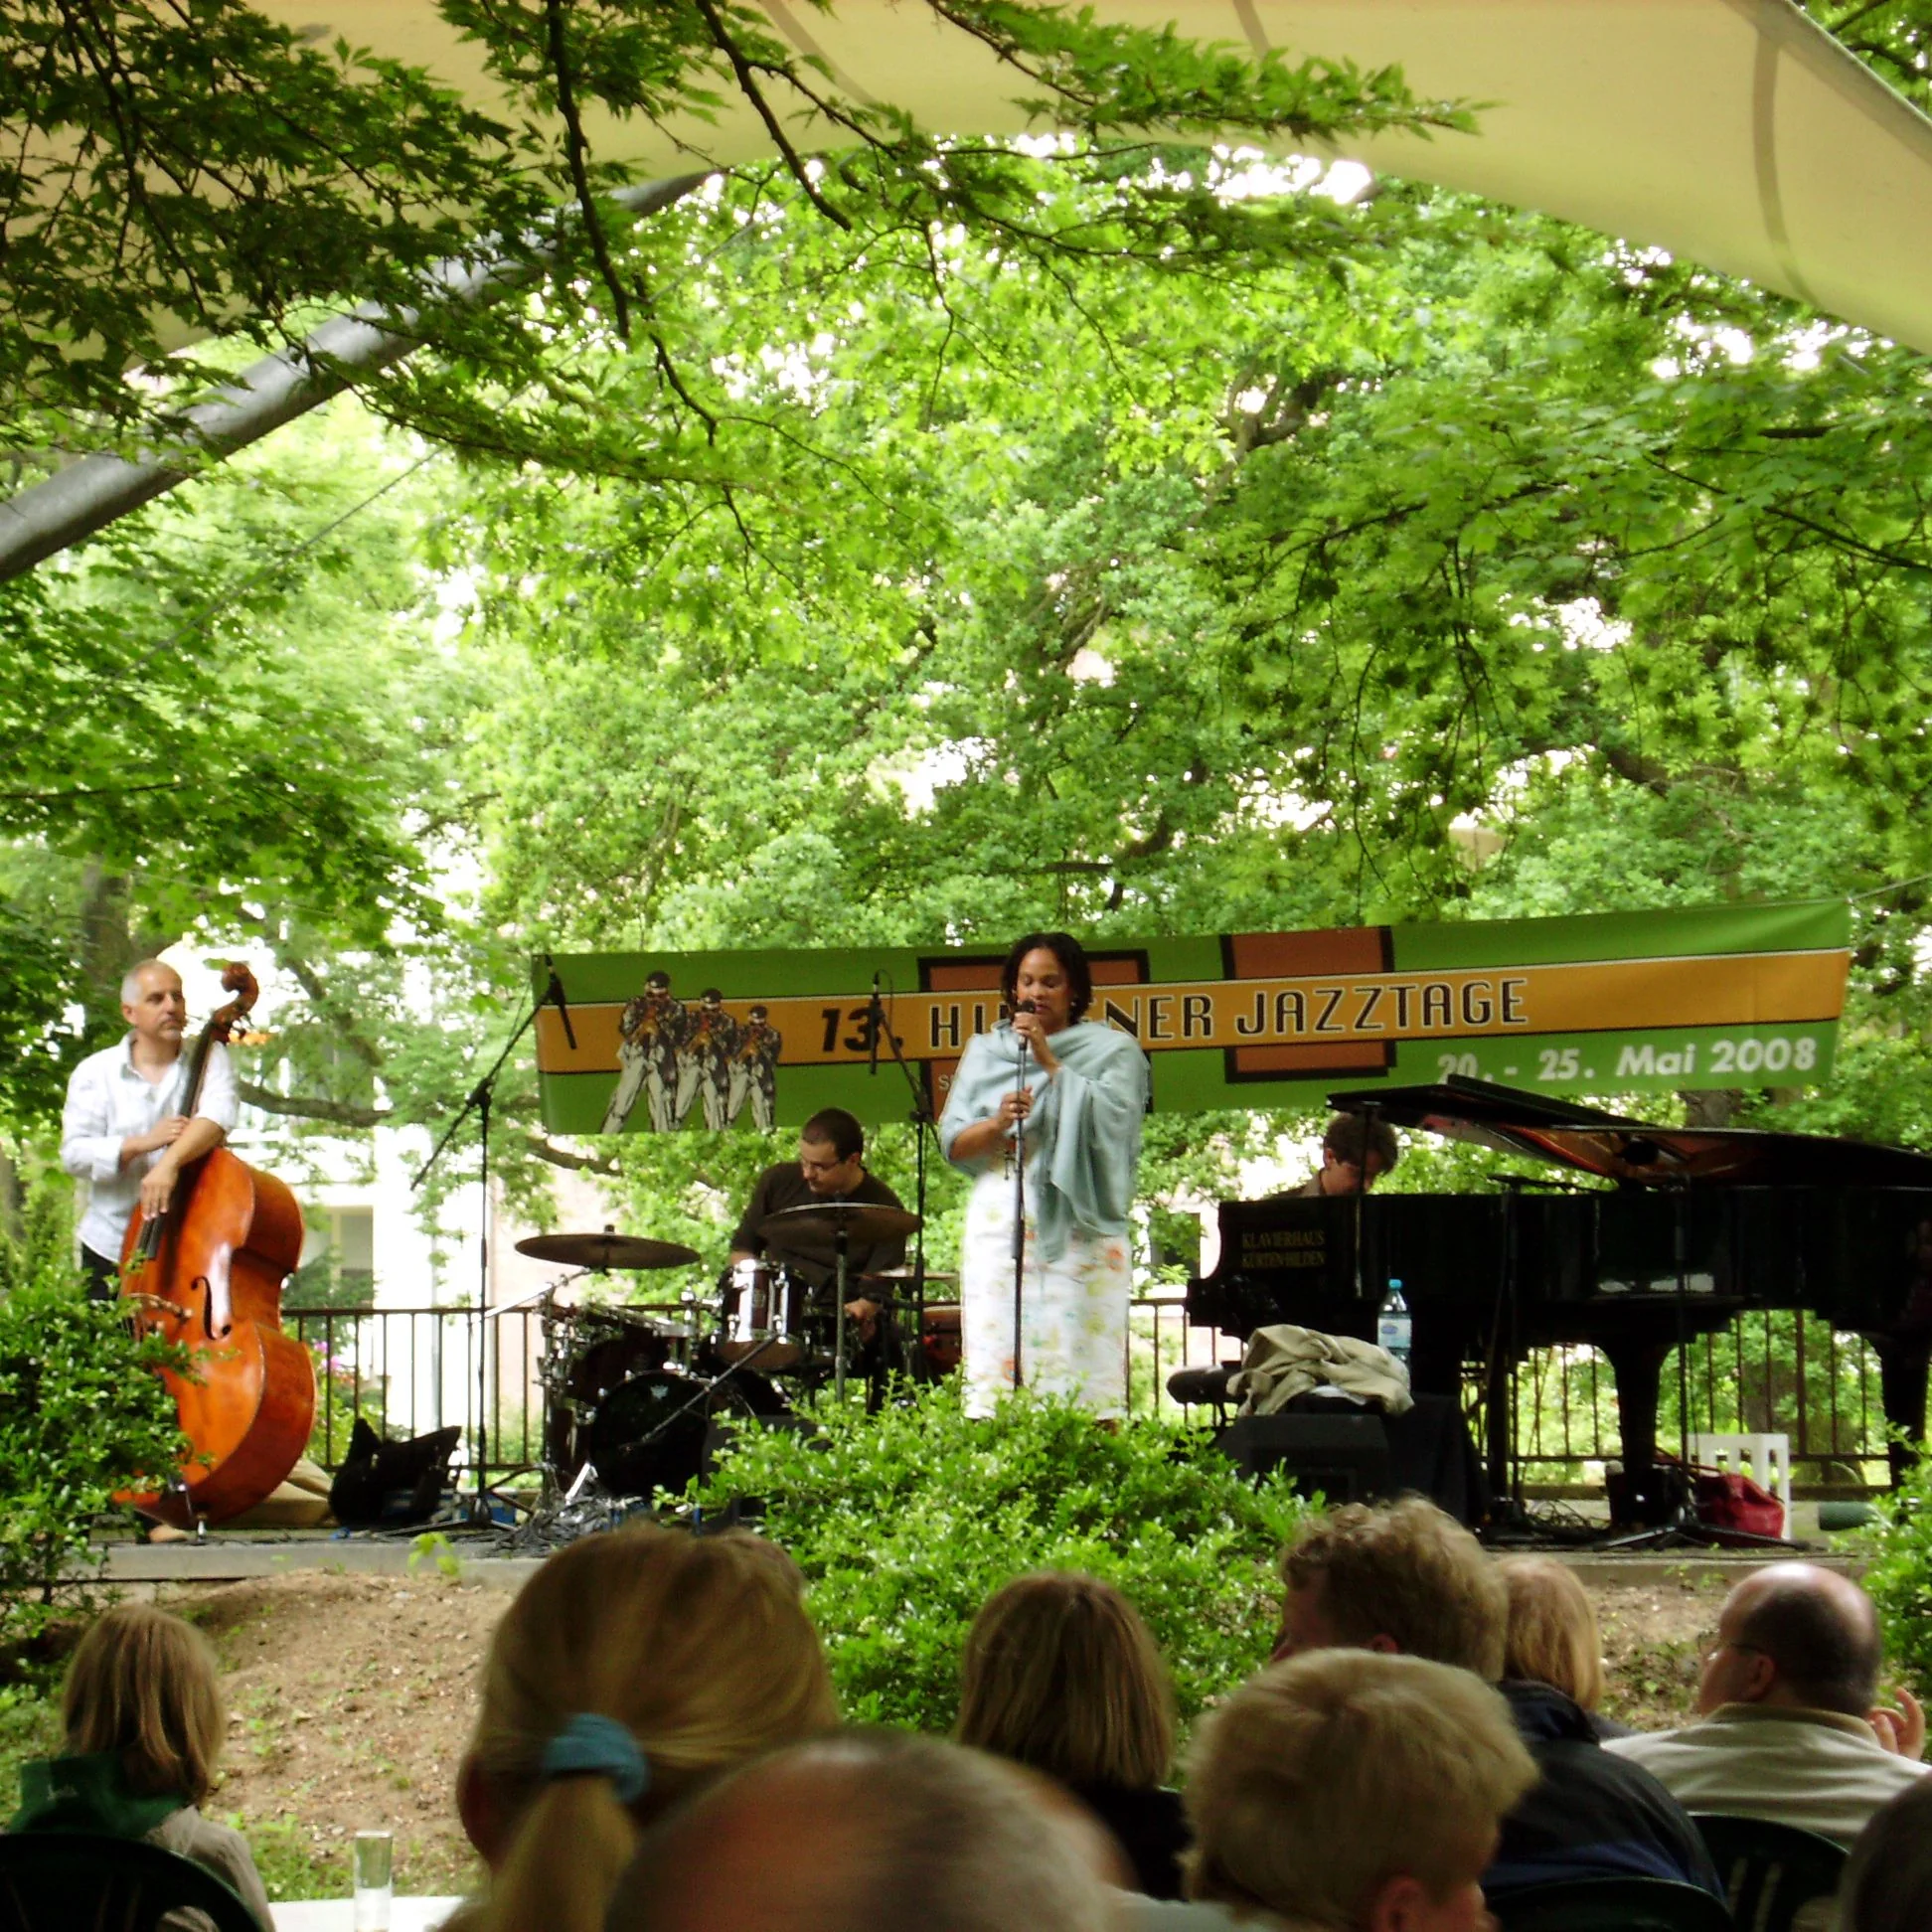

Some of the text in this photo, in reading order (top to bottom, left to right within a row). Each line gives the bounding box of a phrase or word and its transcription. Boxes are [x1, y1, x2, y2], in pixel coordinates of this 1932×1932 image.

[1235, 978, 1530, 1039] JAZZTAGE
[1537, 1048, 1596, 1080] 25.
[1615, 1044, 1695, 1077] Mai
[1710, 1037, 1818, 1073] 2008
